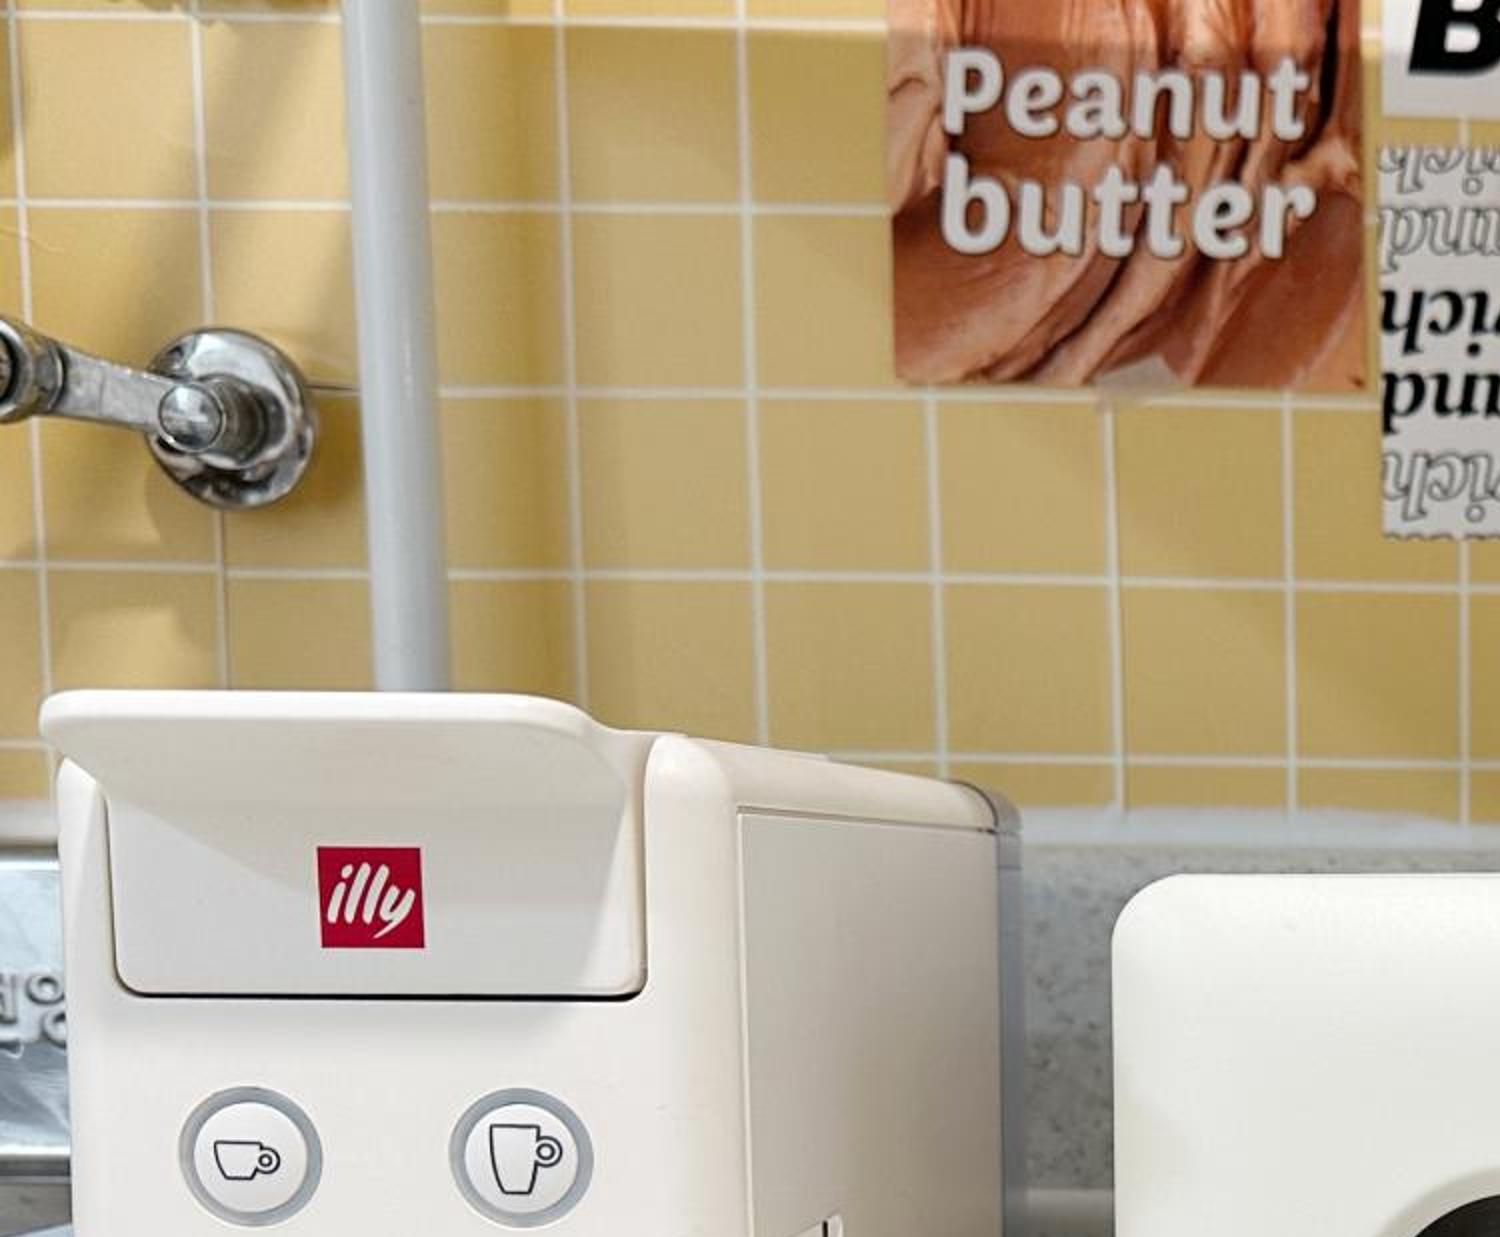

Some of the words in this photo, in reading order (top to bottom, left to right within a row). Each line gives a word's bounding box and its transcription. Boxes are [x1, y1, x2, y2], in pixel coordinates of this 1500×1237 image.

[941, 46, 1310, 141] Peanut
[941, 151, 1317, 259] butter
[327, 861, 416, 939] illy
